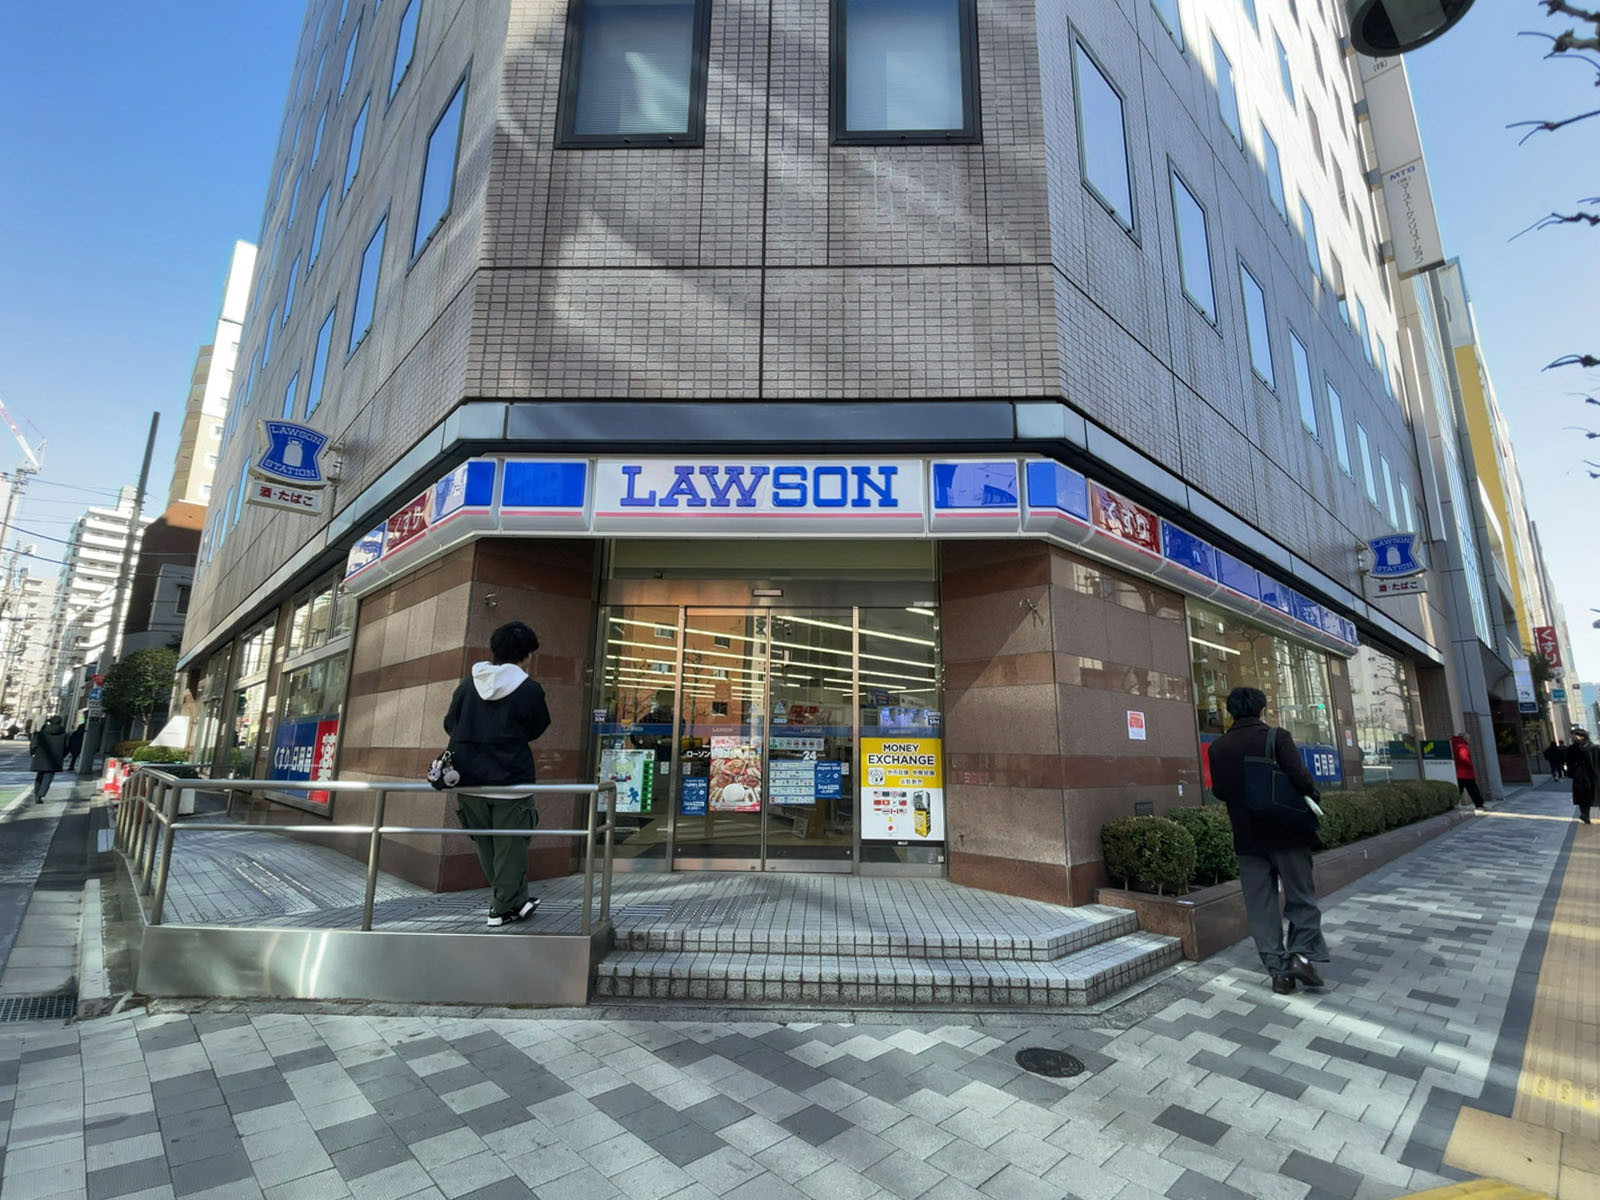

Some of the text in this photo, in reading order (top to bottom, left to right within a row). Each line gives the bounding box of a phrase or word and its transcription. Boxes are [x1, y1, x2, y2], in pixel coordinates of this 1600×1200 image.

[271, 425, 322, 445] LAWSON
[264, 459, 315, 477] STATION
[620, 465, 899, 508] LAWSON
[1373, 537, 1410, 548] LAWSON
[1376, 561, 1414, 573] STATION
[883, 743, 919, 752] MONEY
[803, 751, 817, 760] 24
[868, 754, 935, 765] EXCHANGE
